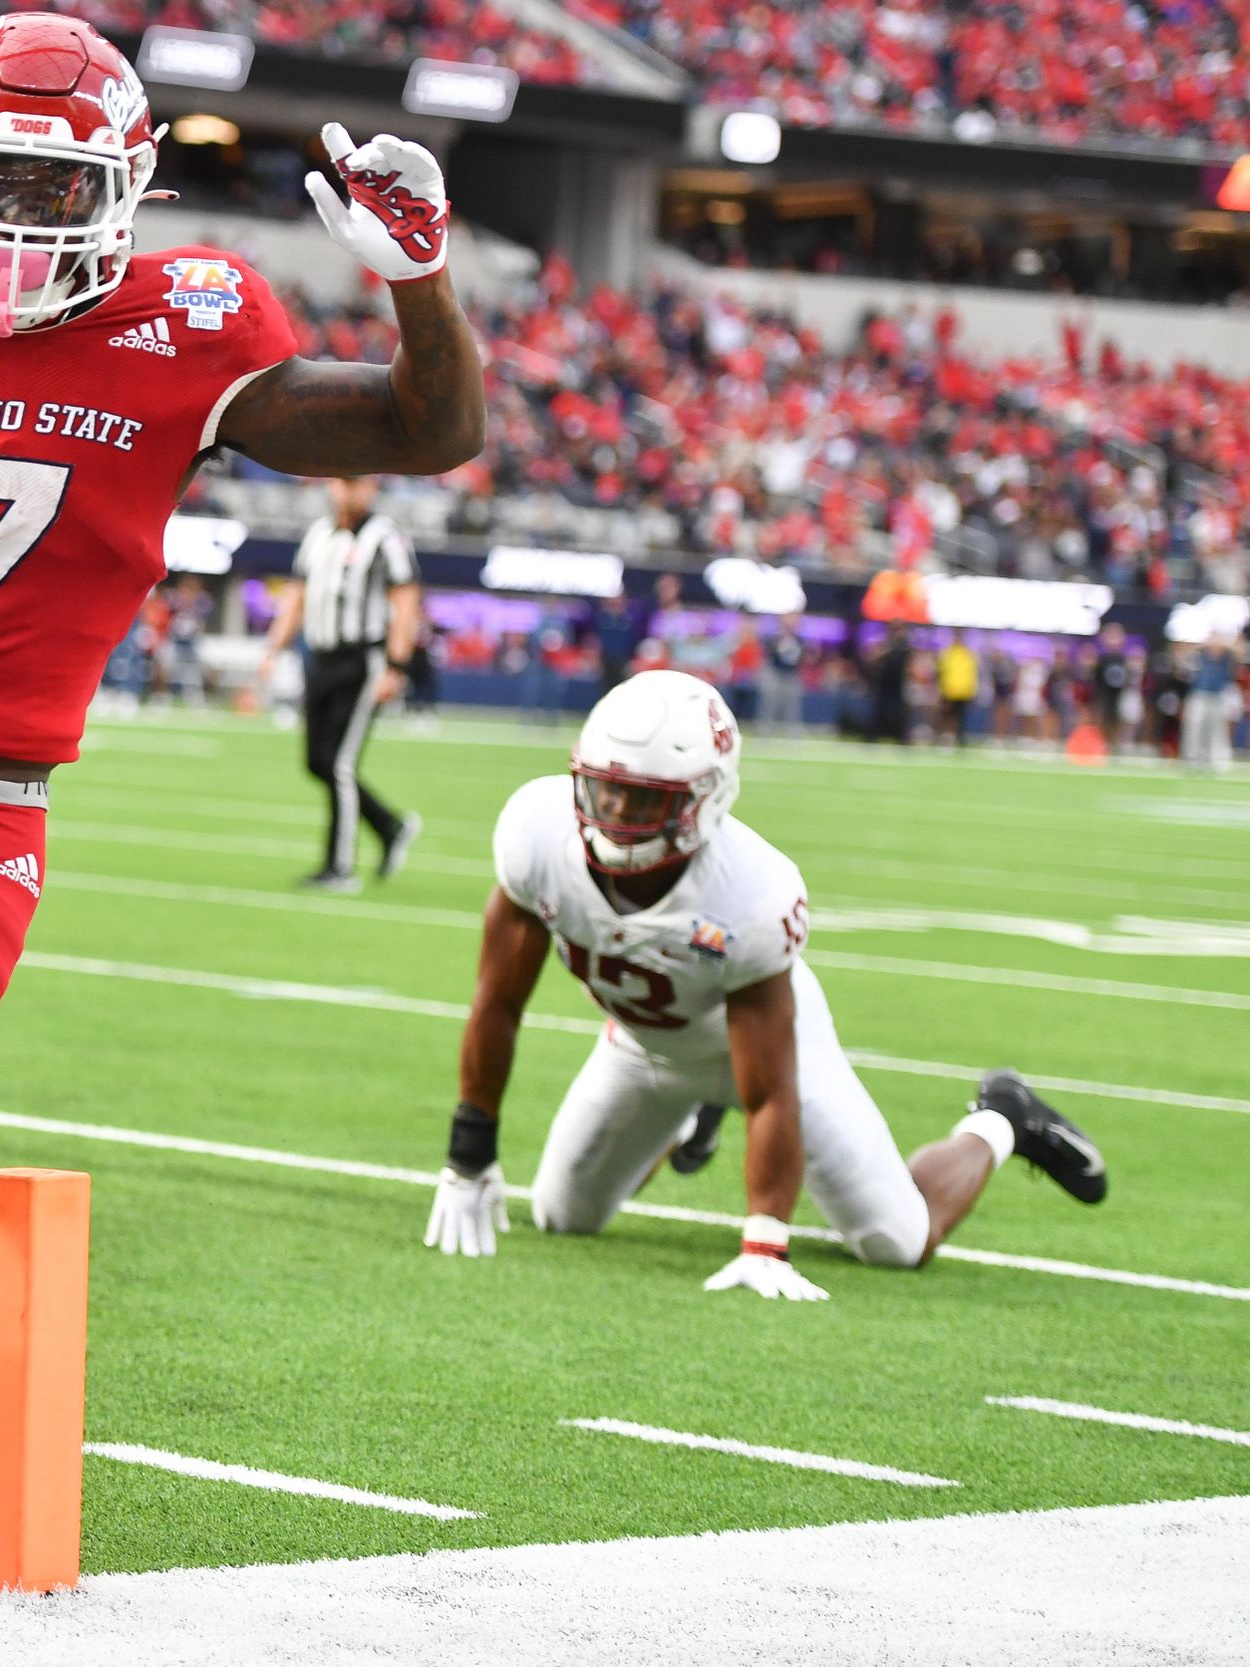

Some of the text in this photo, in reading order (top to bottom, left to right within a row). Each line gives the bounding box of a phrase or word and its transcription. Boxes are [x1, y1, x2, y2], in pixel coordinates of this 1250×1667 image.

[173, 293, 235, 310] BOWL
[108, 335, 177, 357] adidas
[34, 402, 143, 452] STATE
